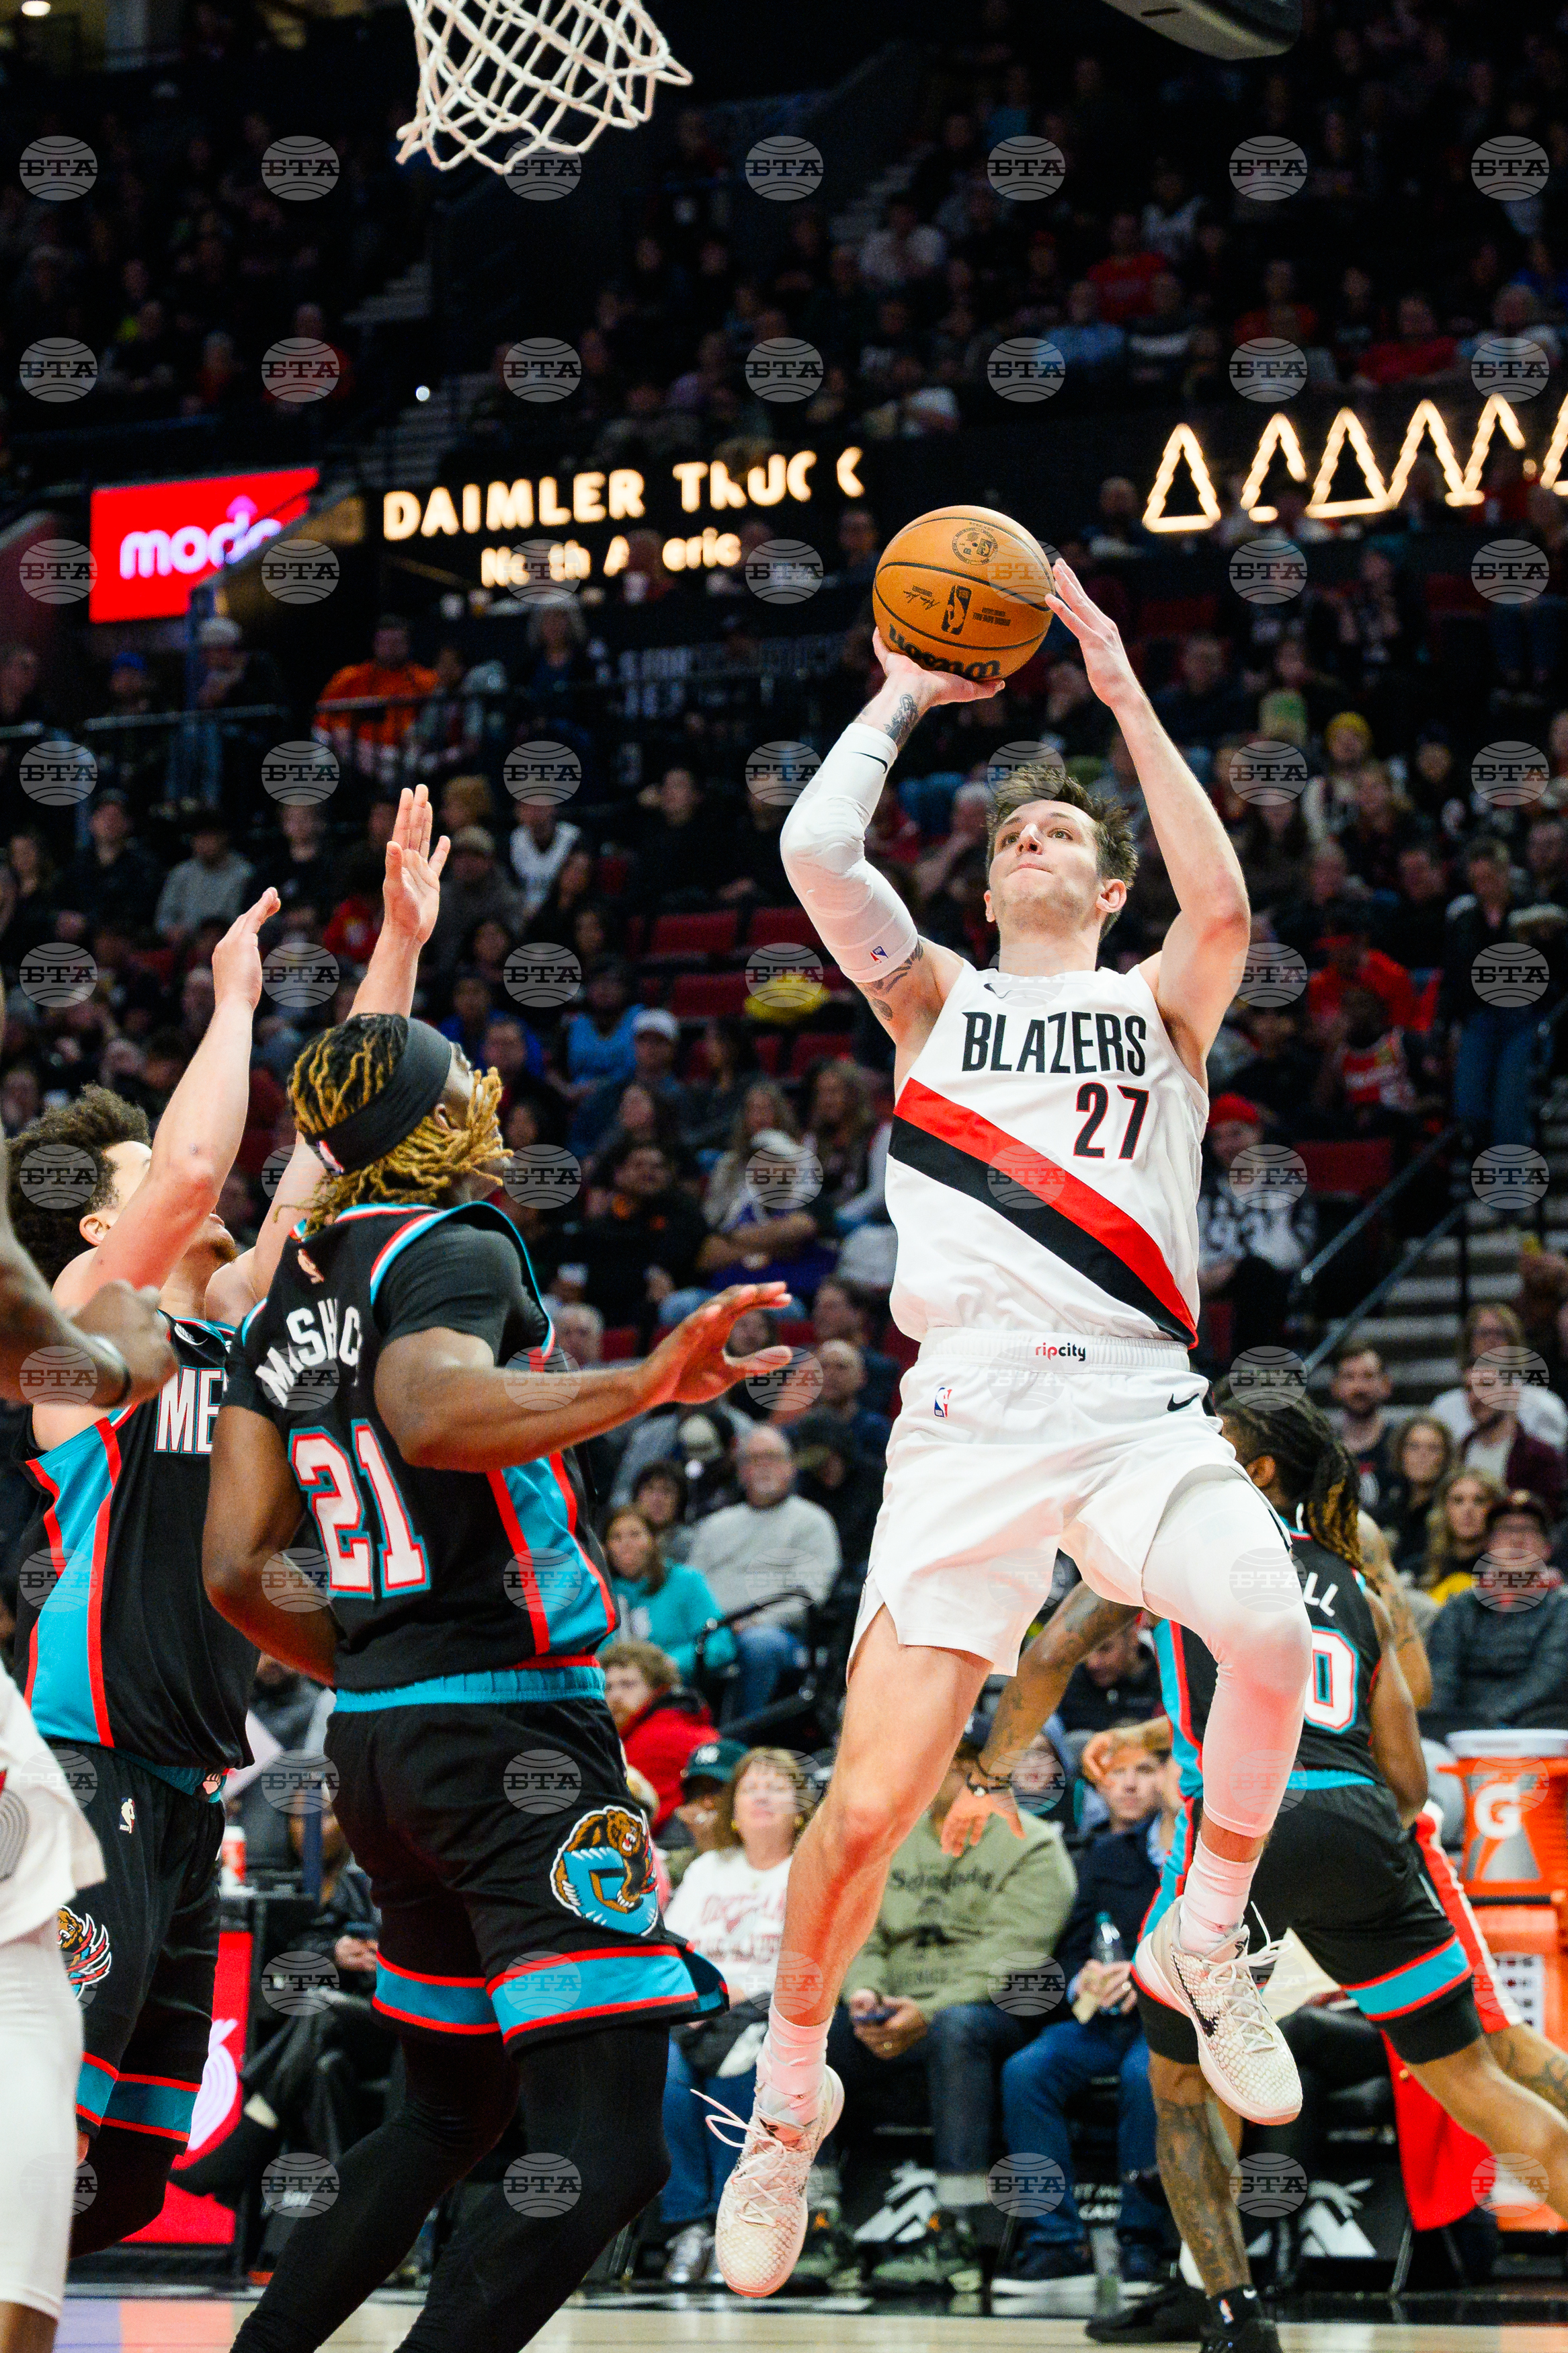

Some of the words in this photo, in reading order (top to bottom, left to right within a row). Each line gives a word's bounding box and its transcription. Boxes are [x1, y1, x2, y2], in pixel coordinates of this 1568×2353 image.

[383, 469, 646, 541] DAIMLER
[961, 1011, 1147, 1077] BLAZERS
[1073, 1082, 1149, 1160] 27
[1036, 1342, 1086, 1362] ripcity
[288, 1419, 431, 1600] 21
[1473, 1782, 1522, 1837] G
